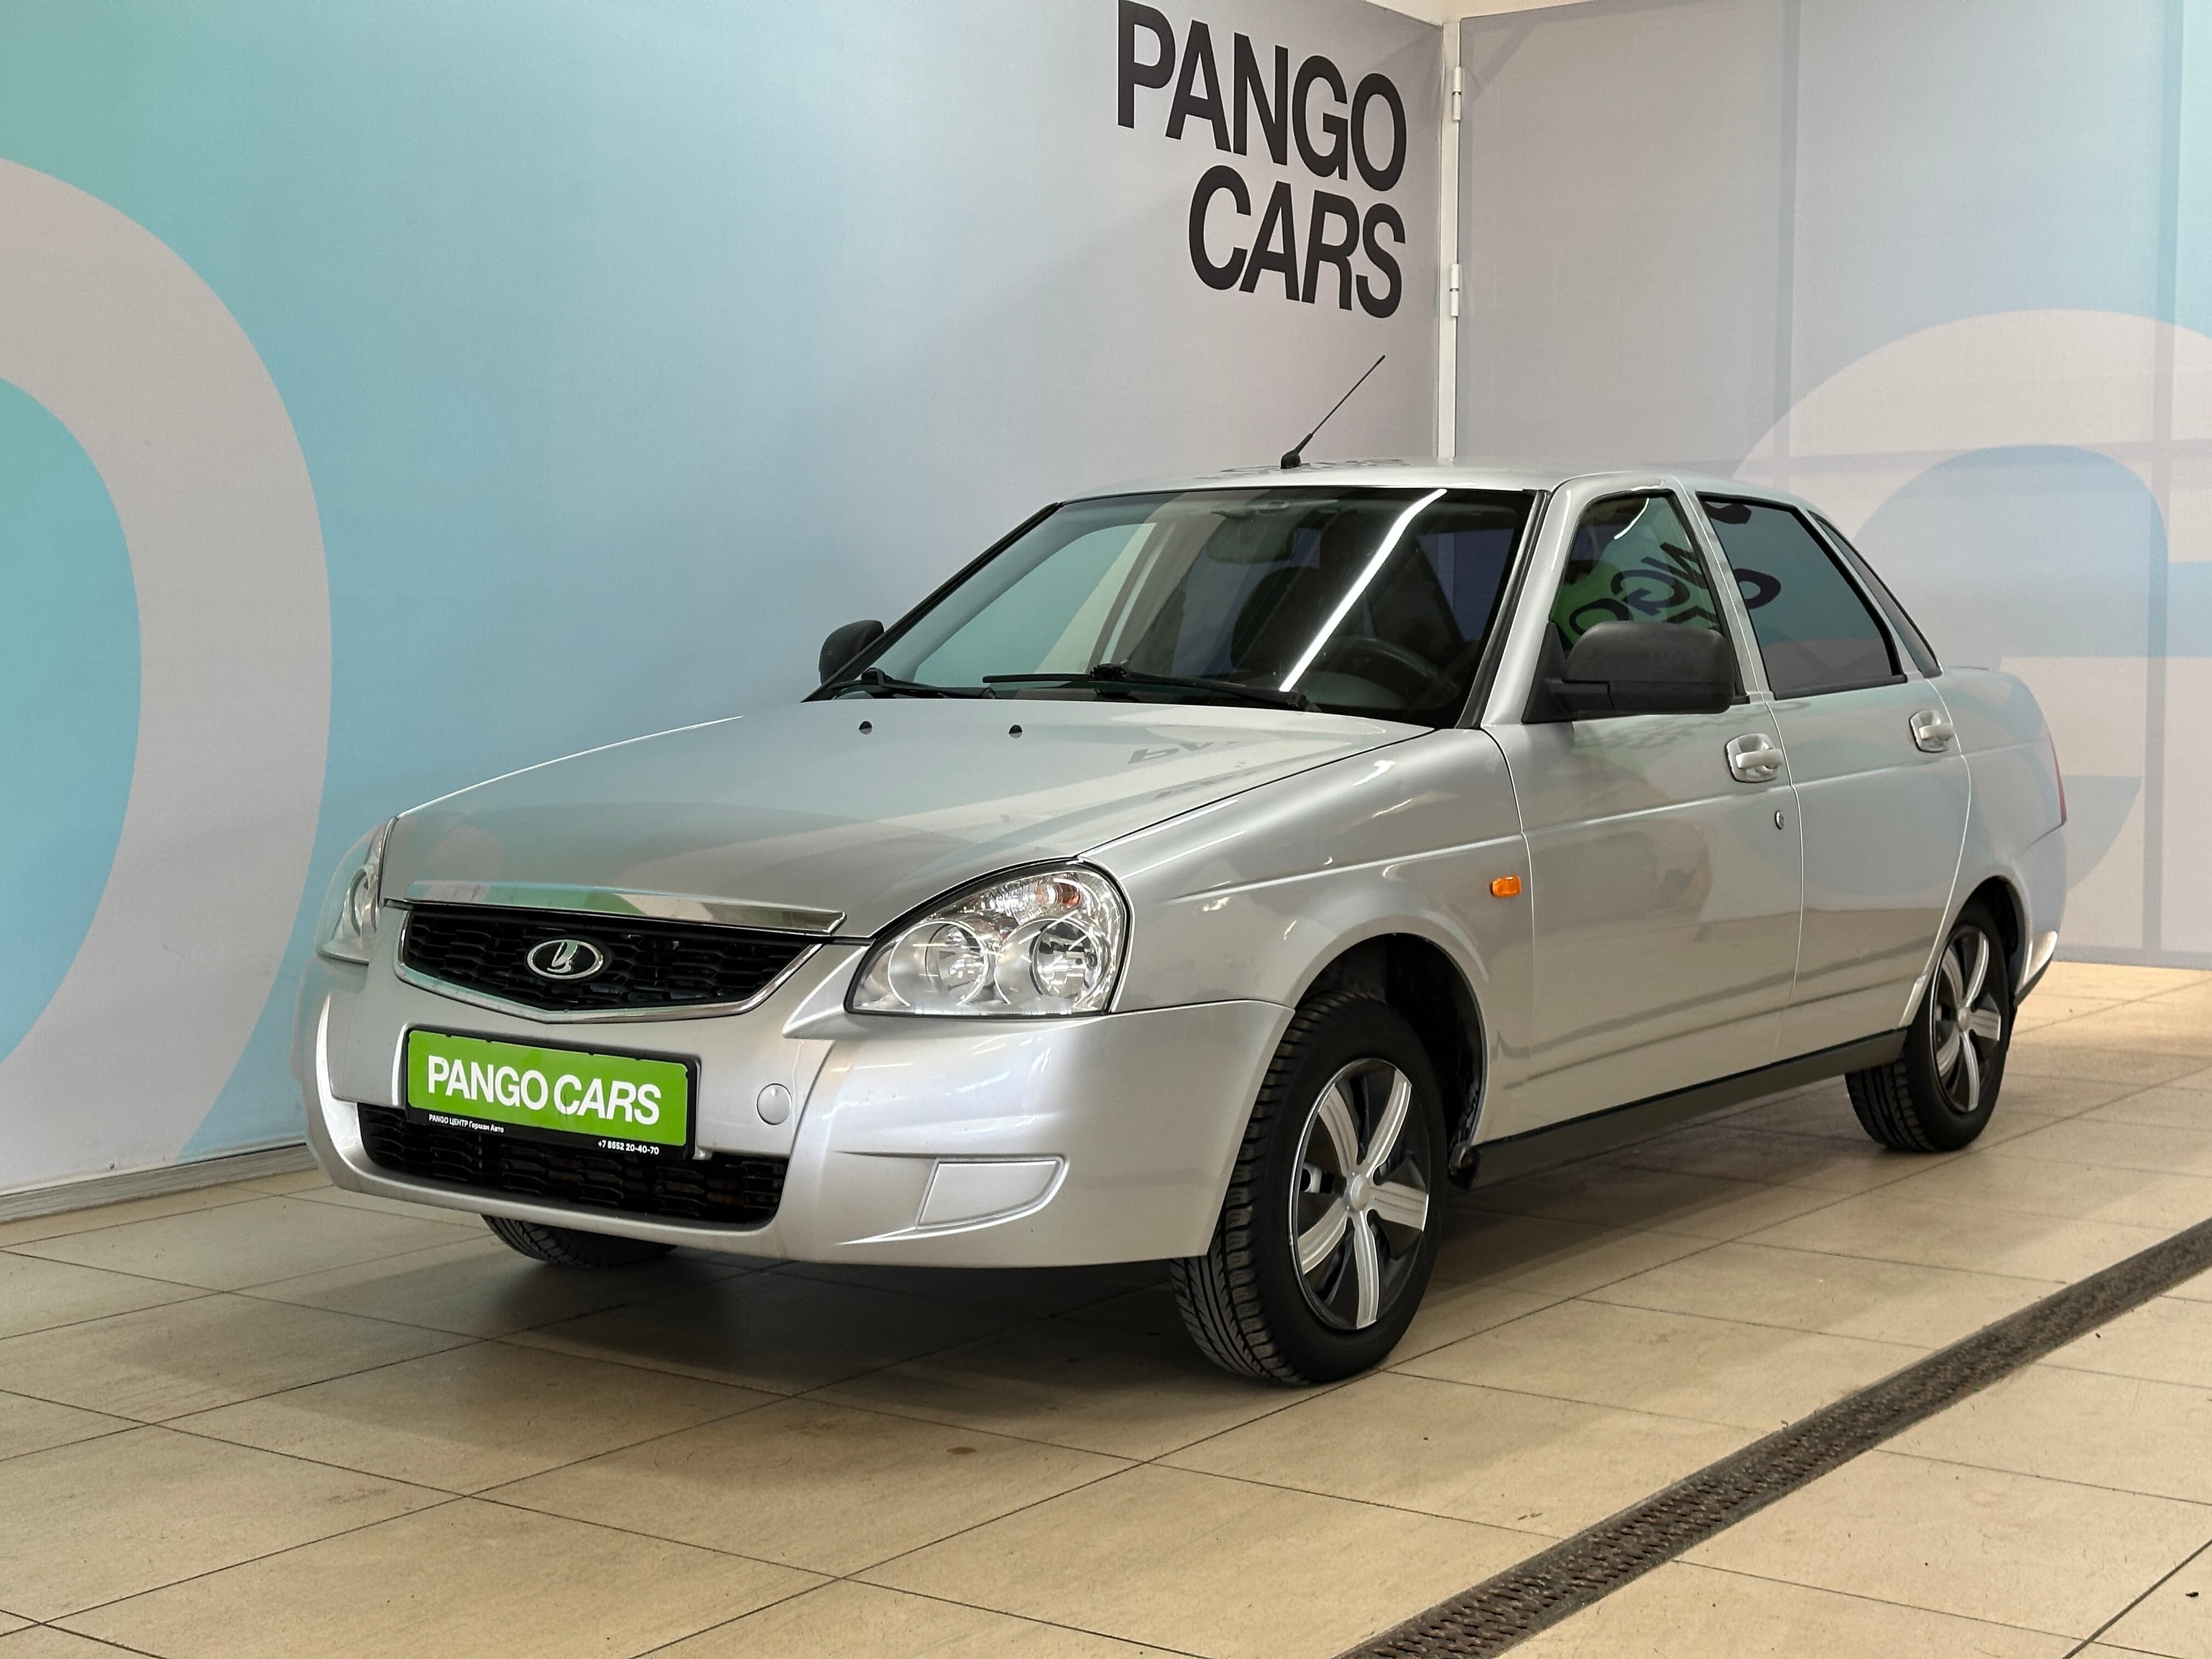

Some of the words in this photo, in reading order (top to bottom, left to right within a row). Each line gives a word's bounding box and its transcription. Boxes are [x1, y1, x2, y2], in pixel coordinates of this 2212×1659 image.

[1118, 0, 1407, 191] PANGO
[1189, 165, 1406, 318] CARS
[427, 1055, 548, 1111] PANGO
[554, 1074, 661, 1125] CARS
[429, 1113, 449, 1124] PANGO
[449, 1118, 468, 1127] ЦЕНТР
[490, 1124, 504, 1133] Авто
[598, 1140, 607, 1148] +7
[626, 1143, 660, 1155] 20-40-70
